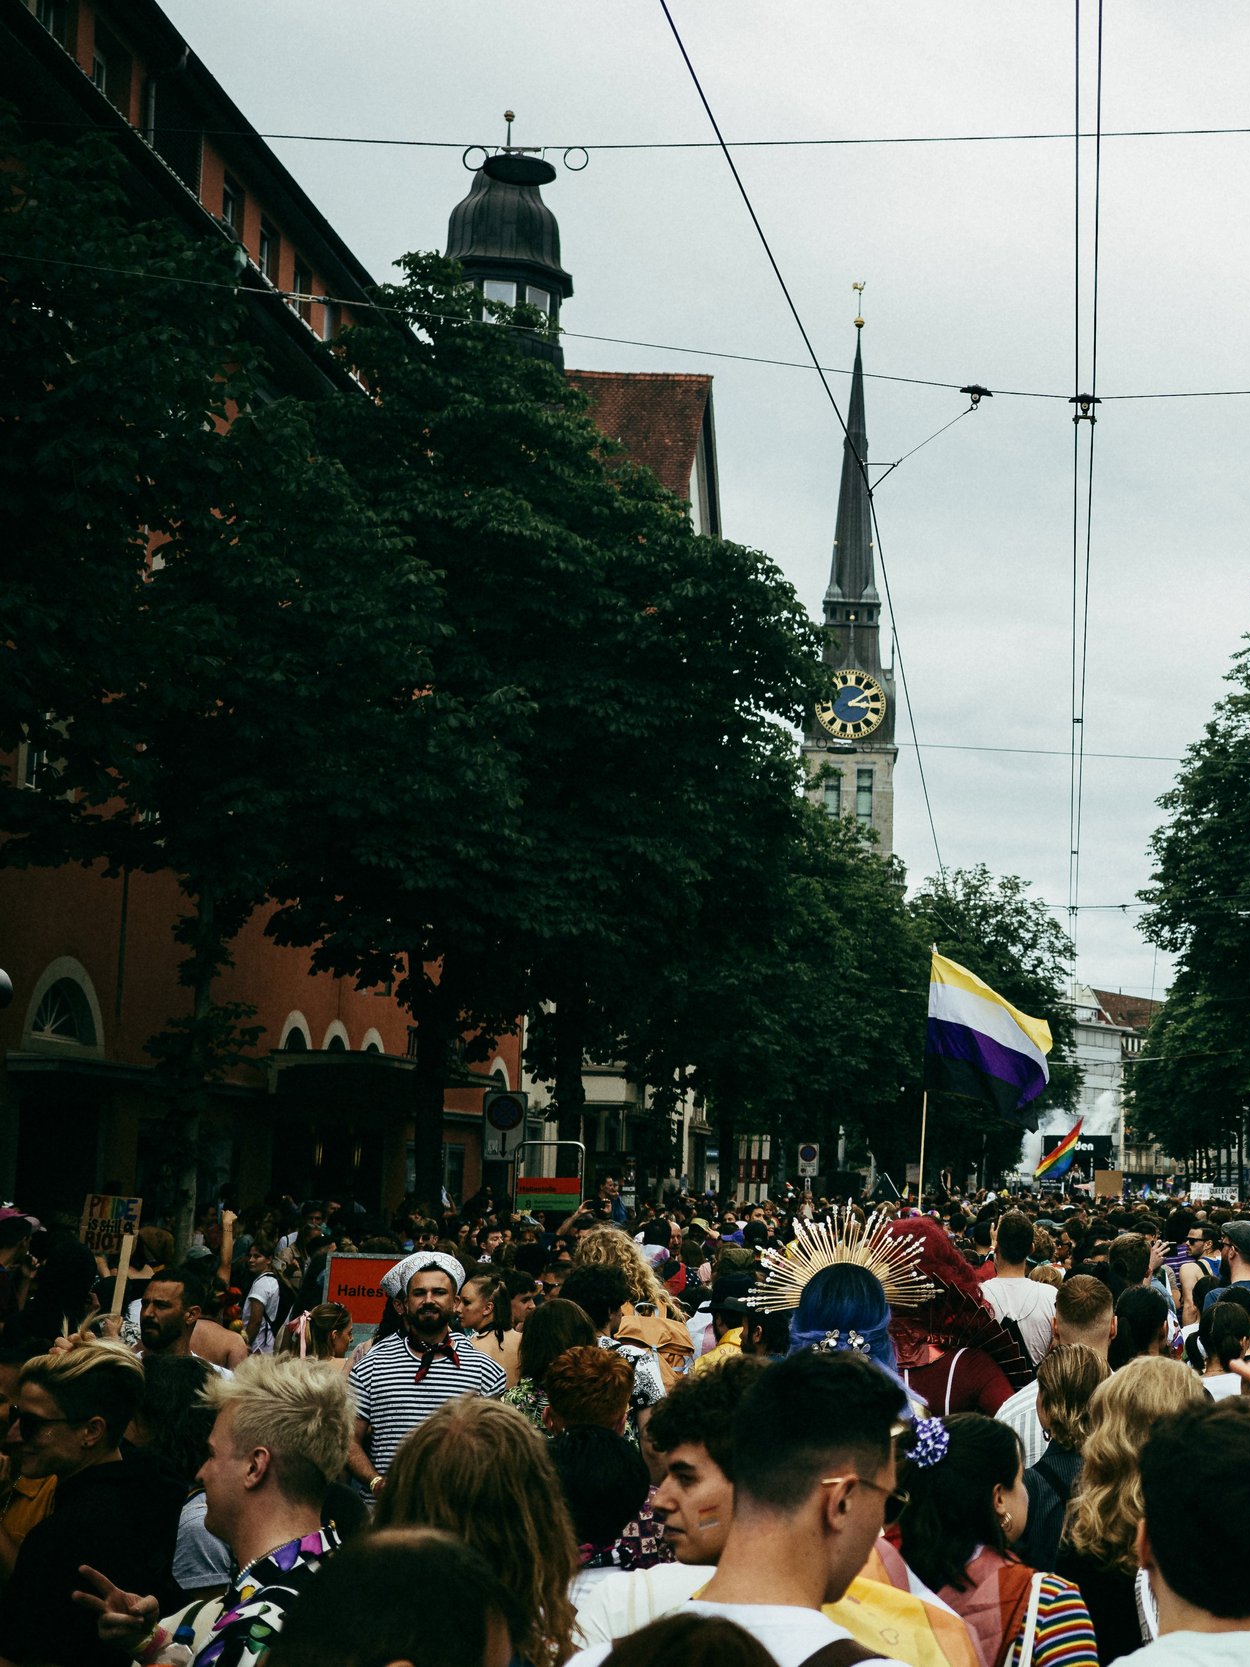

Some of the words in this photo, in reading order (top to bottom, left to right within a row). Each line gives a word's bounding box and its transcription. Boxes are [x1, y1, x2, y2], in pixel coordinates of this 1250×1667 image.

[89, 1196, 138, 1220] PRIDE
[88, 1219, 98, 1230] is
[85, 1231, 124, 1251] RIOT
[337, 1285, 388, 1298] Haltes
